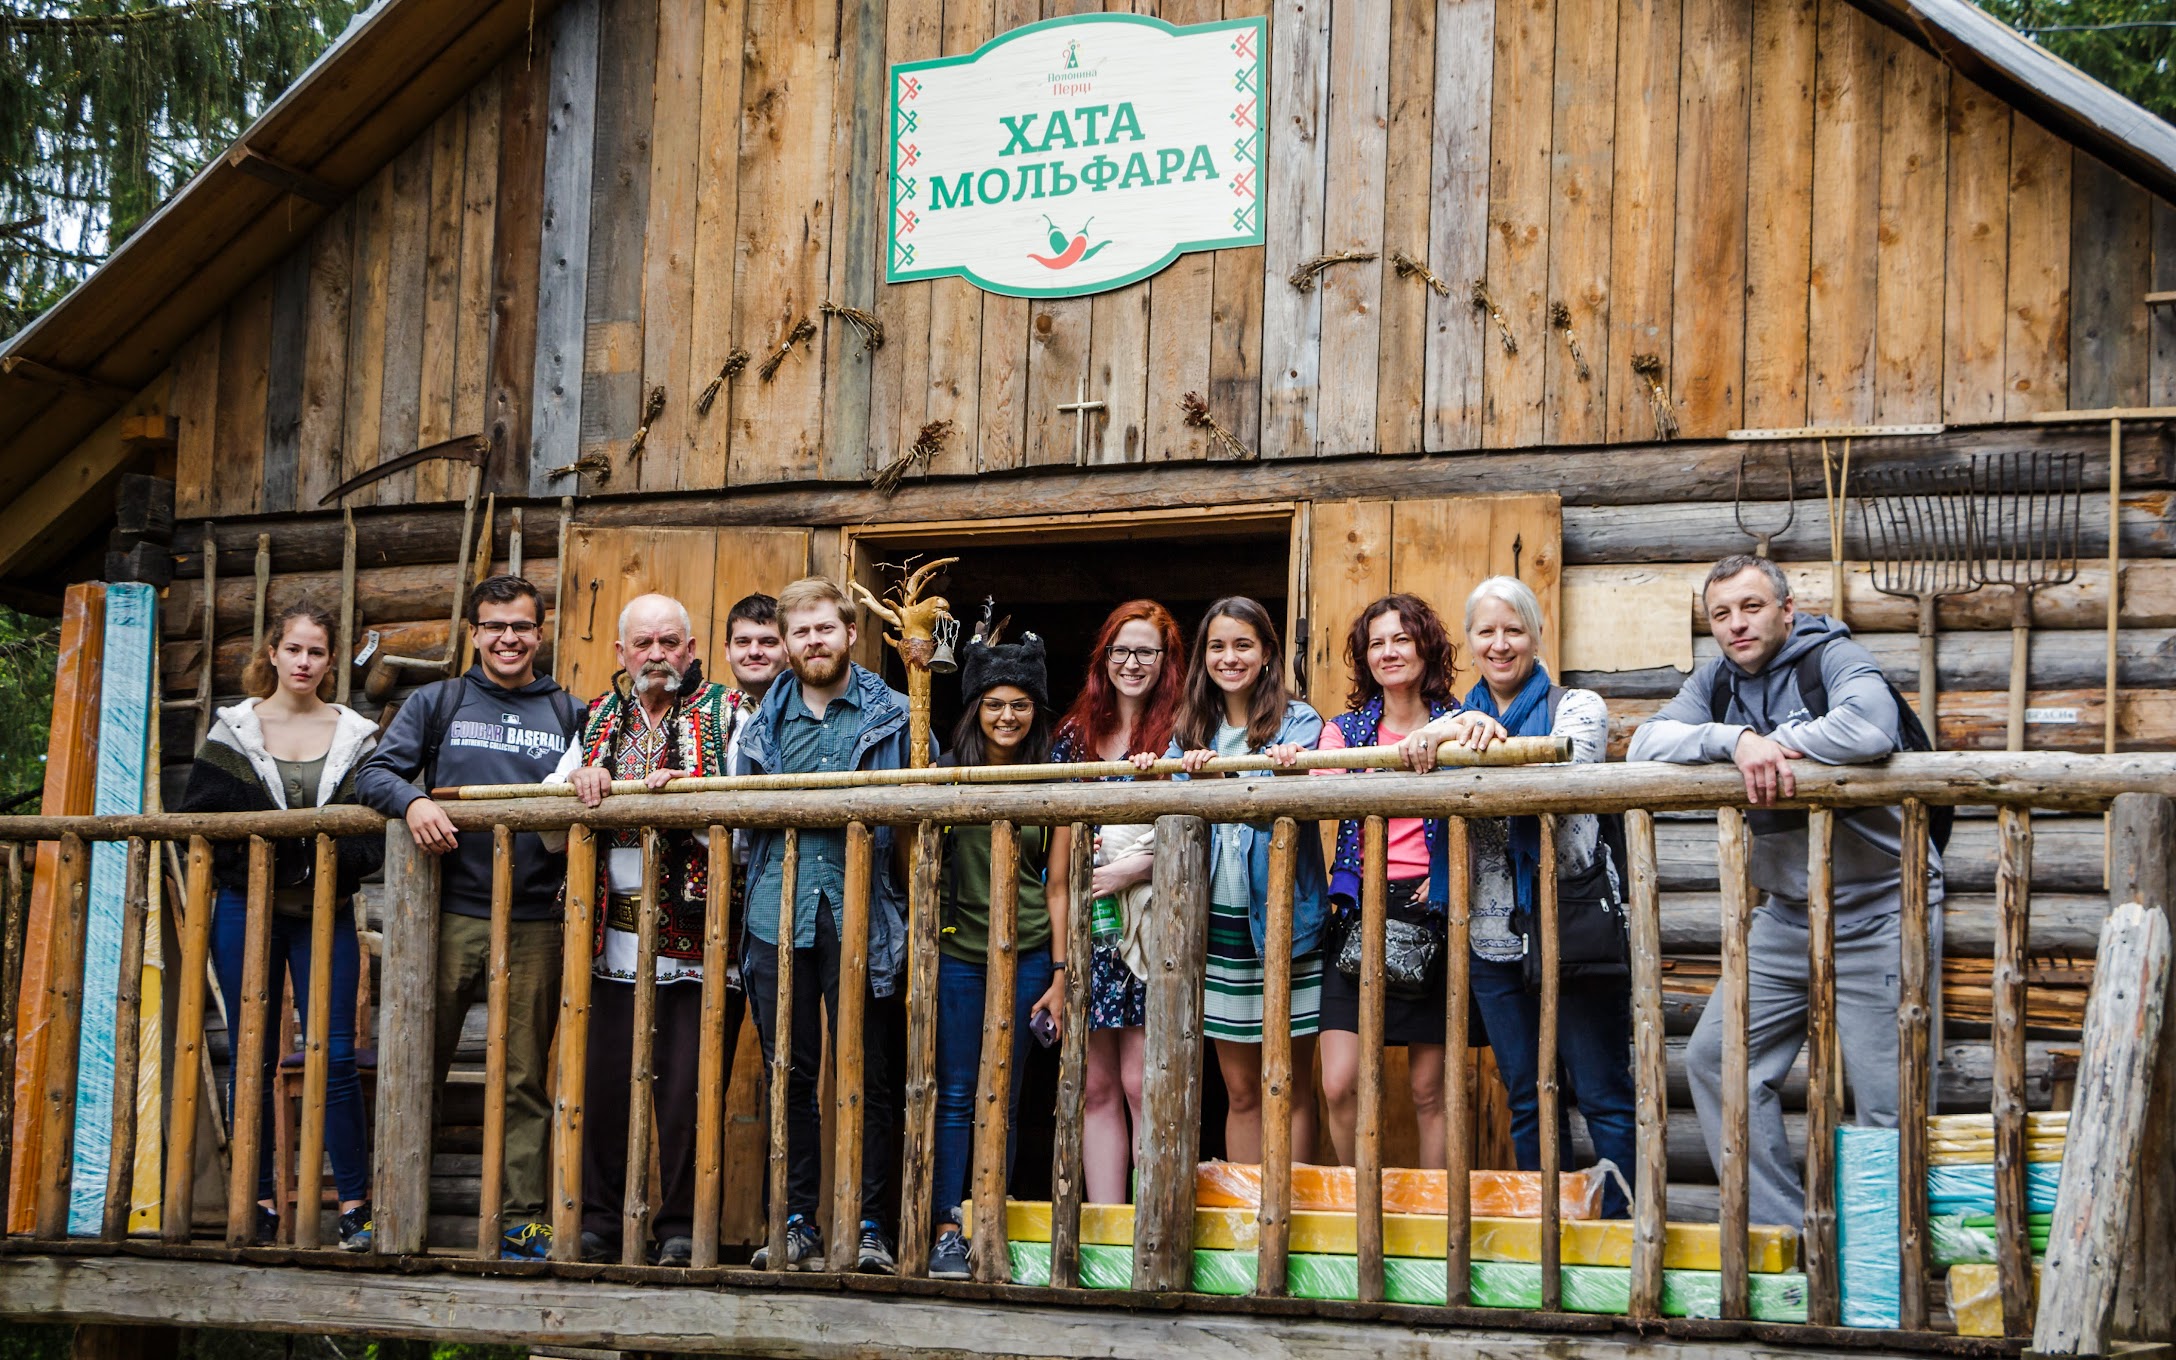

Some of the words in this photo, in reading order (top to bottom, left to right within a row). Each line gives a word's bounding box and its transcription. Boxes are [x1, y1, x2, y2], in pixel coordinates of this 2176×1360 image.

[1047, 70, 1097, 83] Полонина
[1053, 82, 1092, 97] Перці
[998, 102, 1145, 157] ХАТА
[928, 144, 1220, 212] МОЛЬФАРА
[450, 720, 504, 743] COUGAR
[506, 727, 566, 754] BASEBALL
[461, 738, 489, 749] AUTHENTIC
[489, 741, 520, 754] COLLECTION
